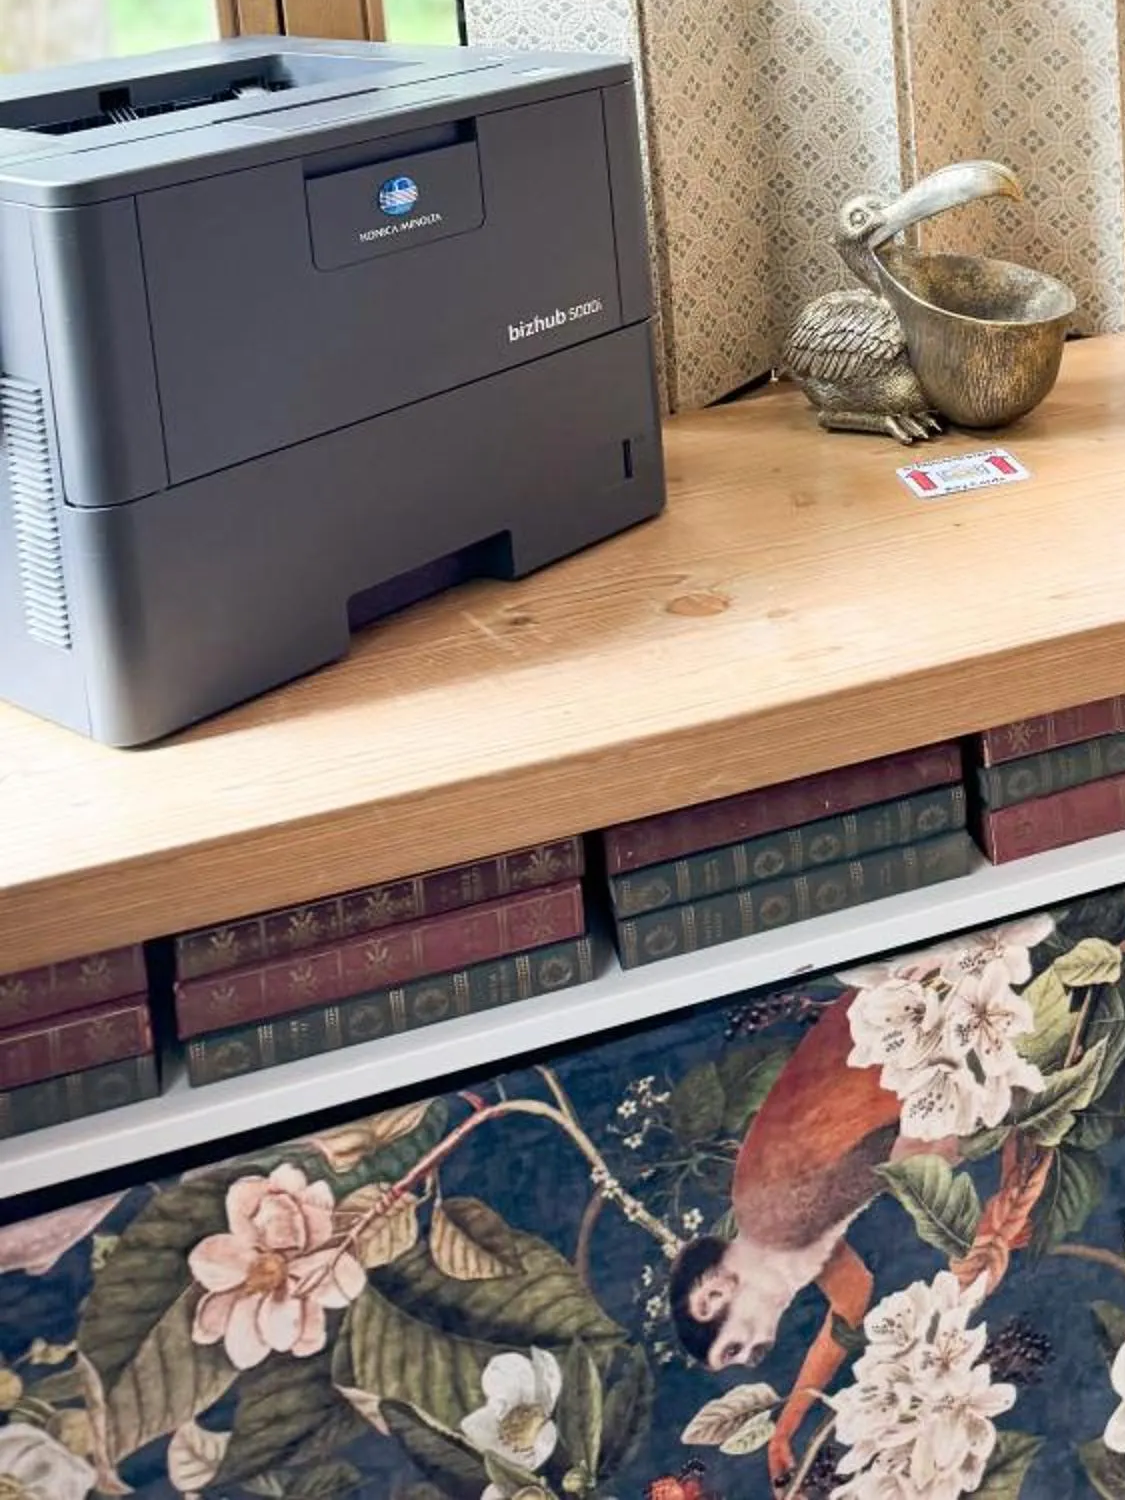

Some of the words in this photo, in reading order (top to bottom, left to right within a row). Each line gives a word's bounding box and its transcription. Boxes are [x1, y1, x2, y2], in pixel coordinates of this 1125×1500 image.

[360, 225, 399, 242] KONICA
[401, 213, 442, 230] MINOLTA
[508, 308, 567, 342] bizhub
